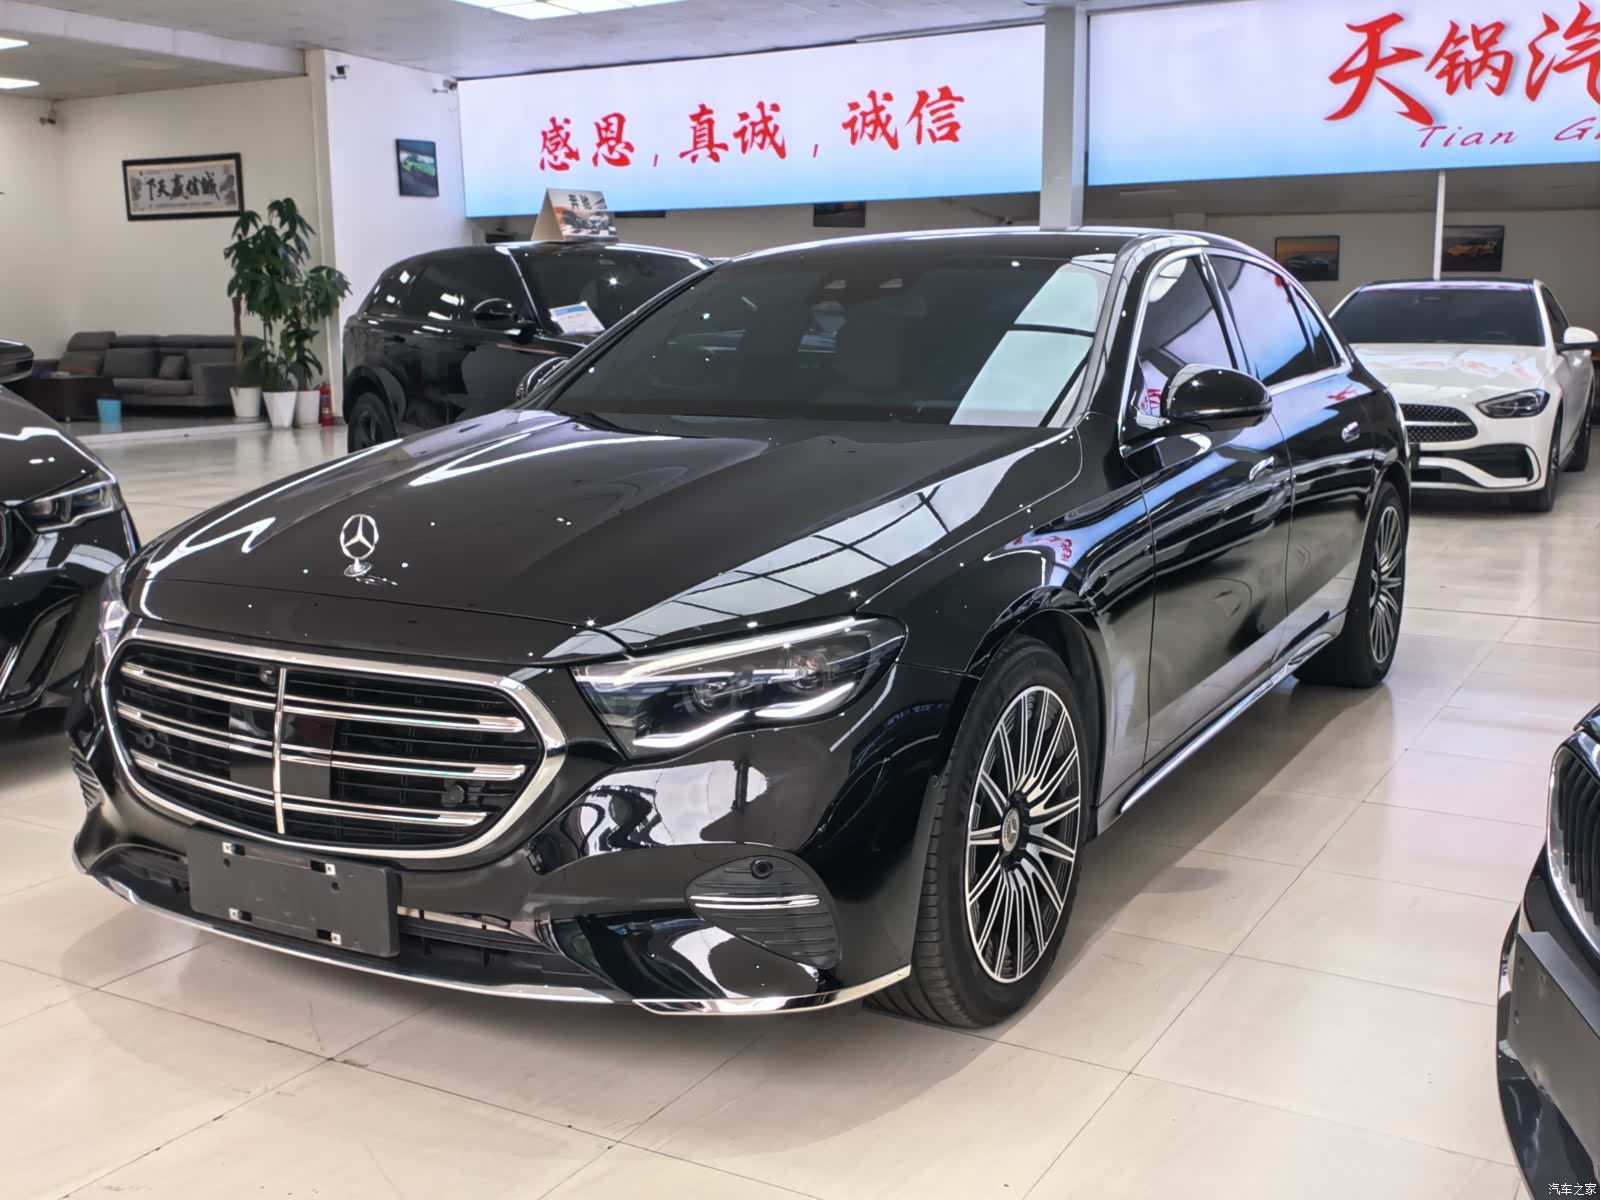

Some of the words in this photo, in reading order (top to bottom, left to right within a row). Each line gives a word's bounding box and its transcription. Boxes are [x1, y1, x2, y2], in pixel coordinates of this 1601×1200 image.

[1323, 1, 1600, 126] 天锅汽
[1417, 125, 1518, 148] Tian
[1553, 117, 1600, 141] G
